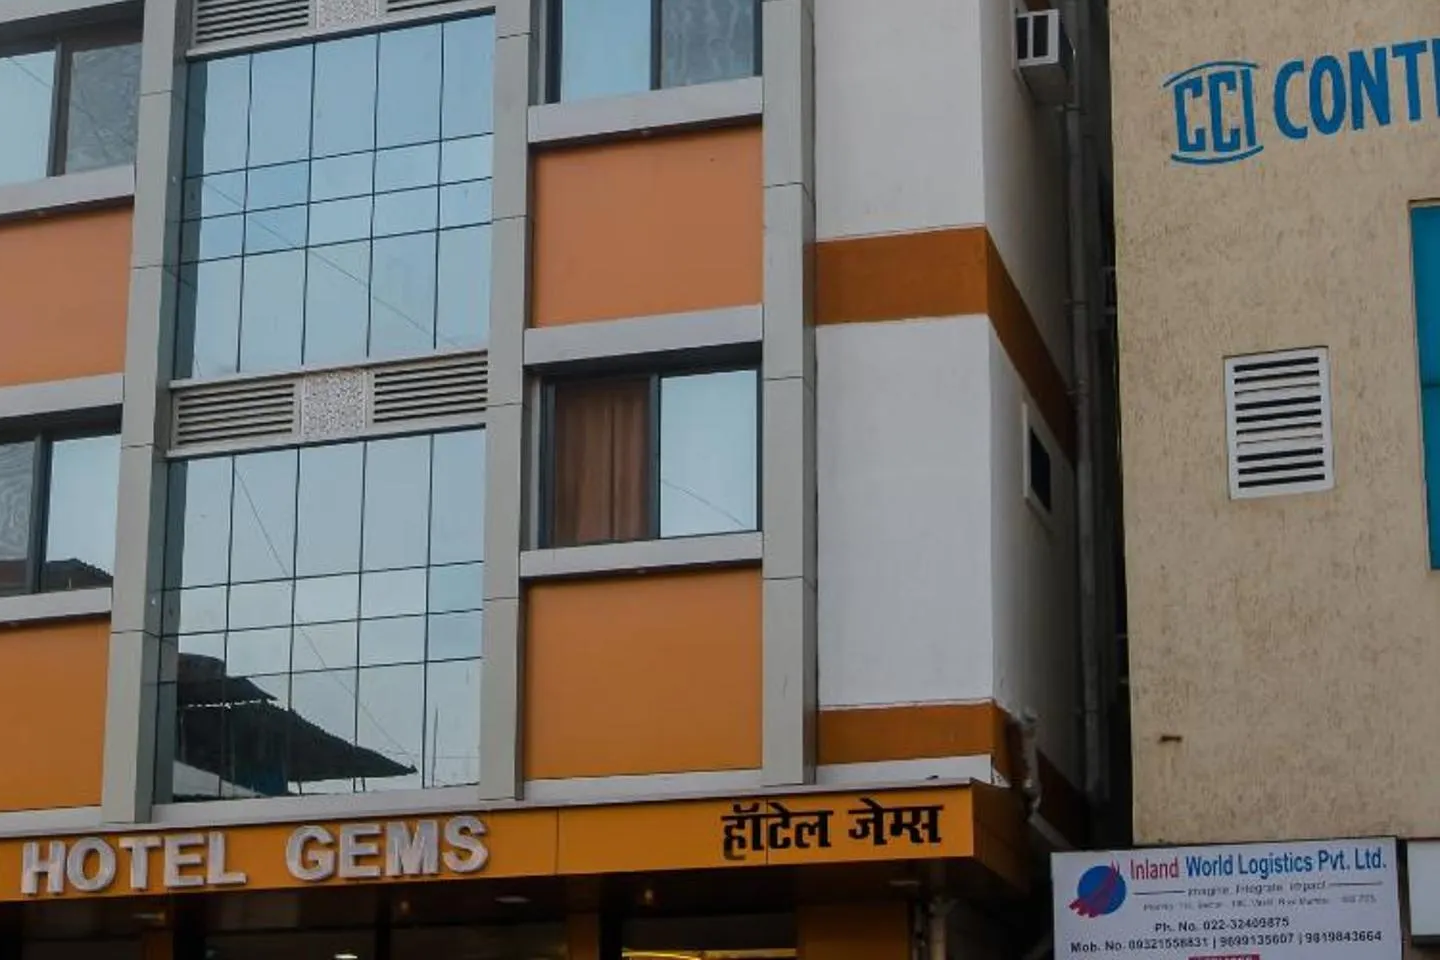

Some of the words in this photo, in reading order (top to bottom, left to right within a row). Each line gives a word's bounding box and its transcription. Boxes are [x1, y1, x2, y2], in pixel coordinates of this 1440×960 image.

[1173, 68, 1257, 153] CCI
[847, 797, 944, 846] जेम्स
[20, 831, 247, 896] HOTEL
[285, 815, 489, 882] GEMS
[1130, 857, 1179, 880] Inland
[1186, 854, 1234, 877] World
[1238, 851, 1313, 880] Logistics
[1318, 850, 1351, 872] Pvt.
[1355, 847, 1387, 870] Ltd.
[1071, 941, 1100, 953] Mob.
